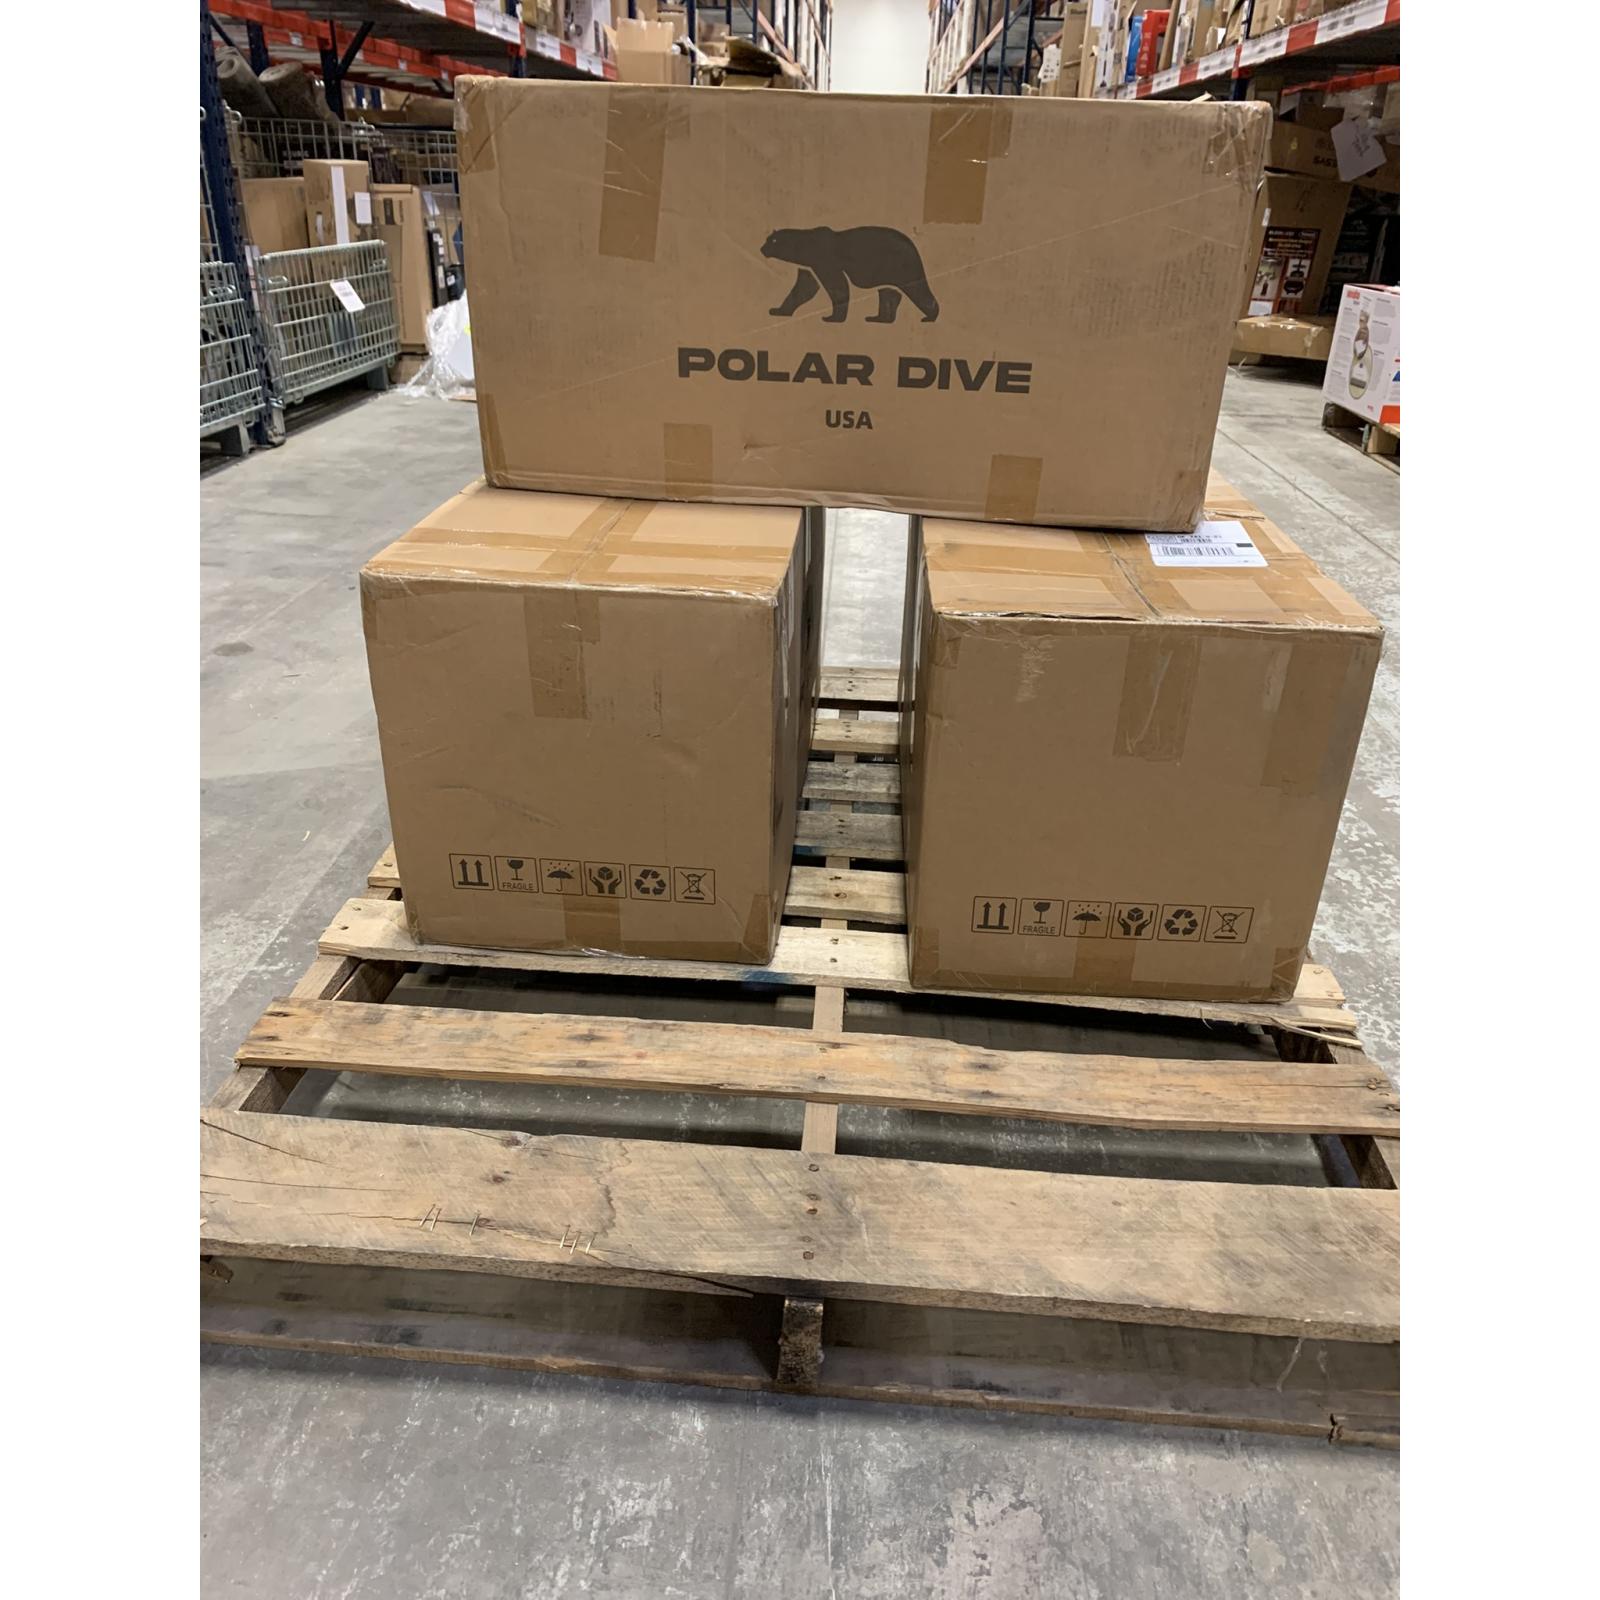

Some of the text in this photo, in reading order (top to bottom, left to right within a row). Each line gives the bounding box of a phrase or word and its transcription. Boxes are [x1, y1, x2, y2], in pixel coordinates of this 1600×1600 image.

[677, 347, 1033, 394] POLAR DIVE
[825, 409, 873, 430] USA
[502, 881, 534, 891] FRAGILE
[1022, 925, 1056, 934] FRAGILE
